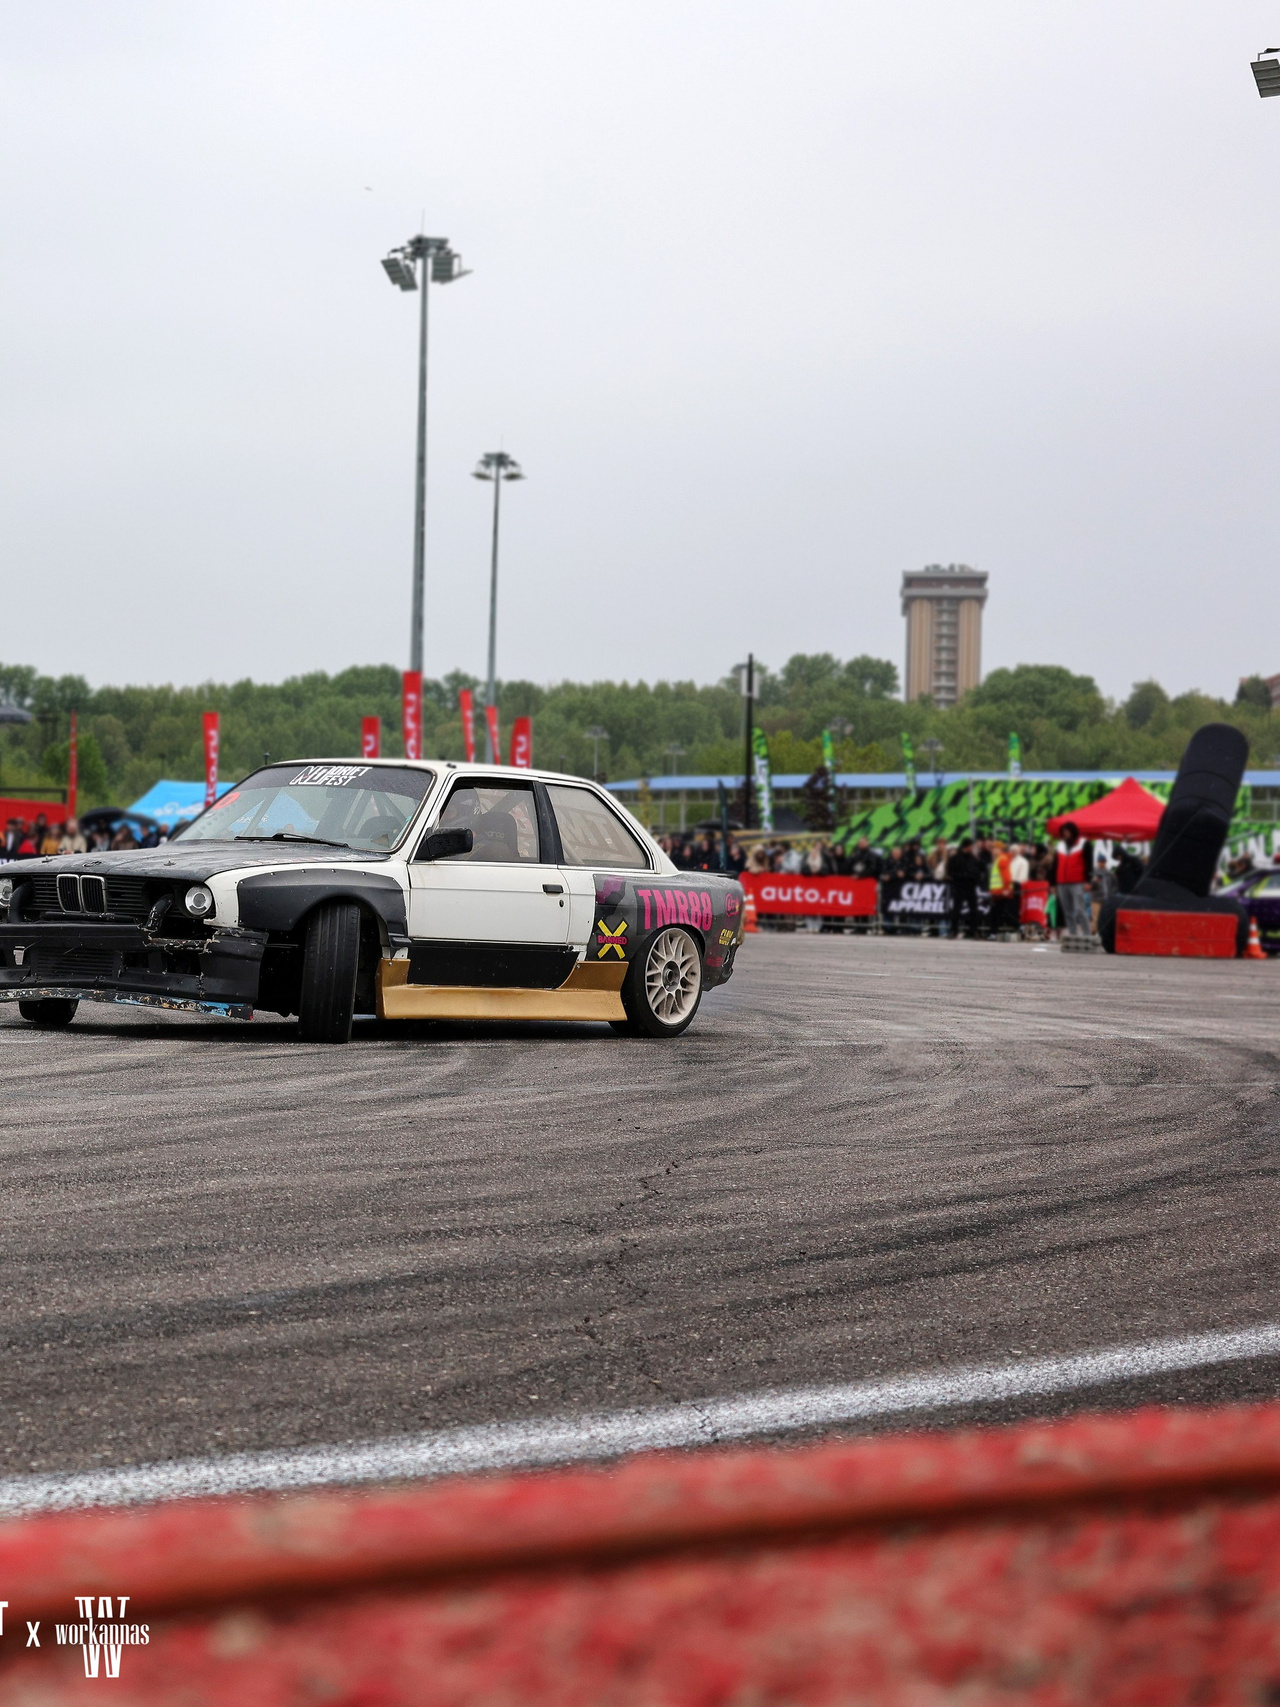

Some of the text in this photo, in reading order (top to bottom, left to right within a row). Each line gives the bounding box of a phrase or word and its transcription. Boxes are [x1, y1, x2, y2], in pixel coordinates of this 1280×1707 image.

[329, 766, 373, 776] DRIFT
[321, 776, 357, 786] FEST
[761, 885, 853, 905] auto.ru
[887, 900, 945, 913] APPAREL
[597, 935, 628, 945] BANNED
